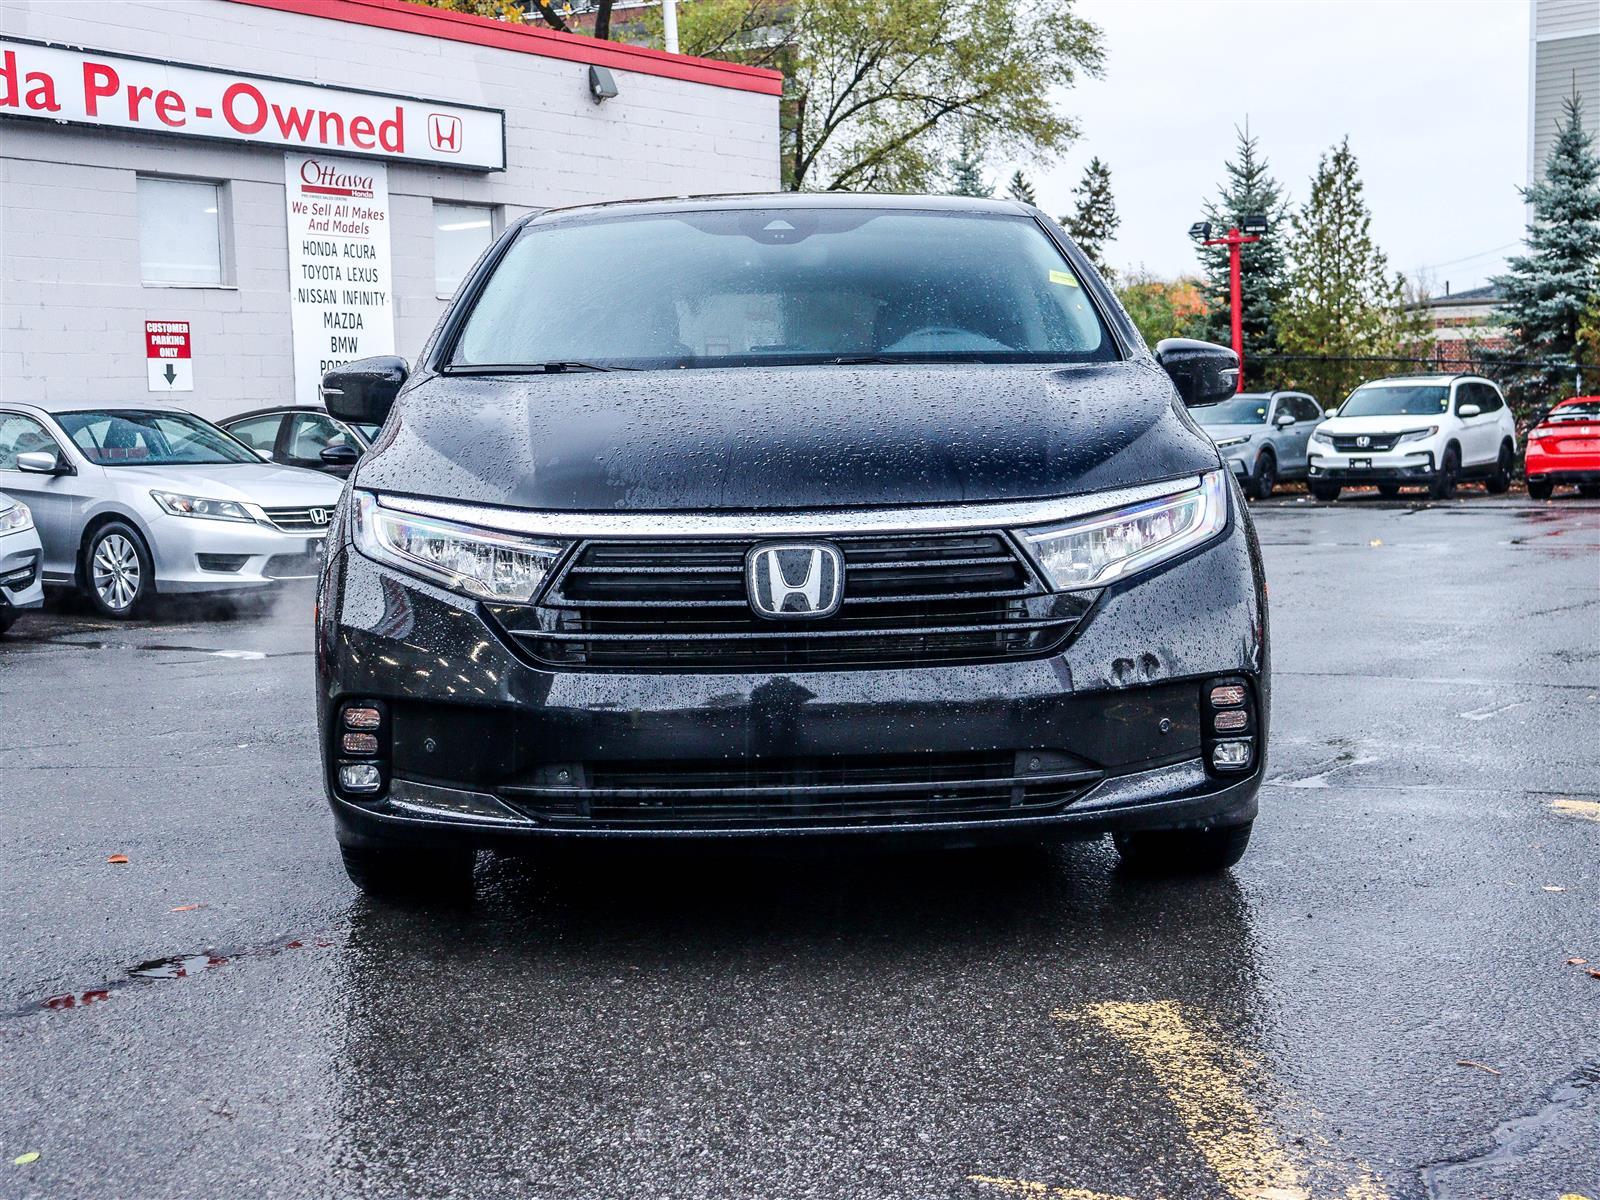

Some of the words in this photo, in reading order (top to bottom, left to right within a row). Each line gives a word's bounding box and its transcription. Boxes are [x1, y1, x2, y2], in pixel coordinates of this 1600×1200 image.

[83, 62, 405, 154] Pre-Owned
[300, 159, 374, 190] Ottawa
[352, 190, 373, 199] Honda
[292, 201, 309, 215] We
[311, 203, 332, 217] Sell
[334, 205, 349, 218] All
[352, 206, 385, 221] Makes
[308, 218, 330, 232] And
[332, 220, 370, 235] Models
[302, 240, 338, 257] HONDA
[343, 243, 377, 260] ACURA
[301, 264, 342, 281] TOYOTA
[347, 267, 379, 283] LEXUS
[298, 288, 337, 304] NISSAN
[342, 290, 386, 306] INFINITY
[146, 322, 189, 334] CUSTOMER
[323, 312, 364, 330] MAZDA
[151, 335, 185, 346] PARKING
[330, 336, 358, 353] BMW
[159, 347, 178, 358] ONLY
